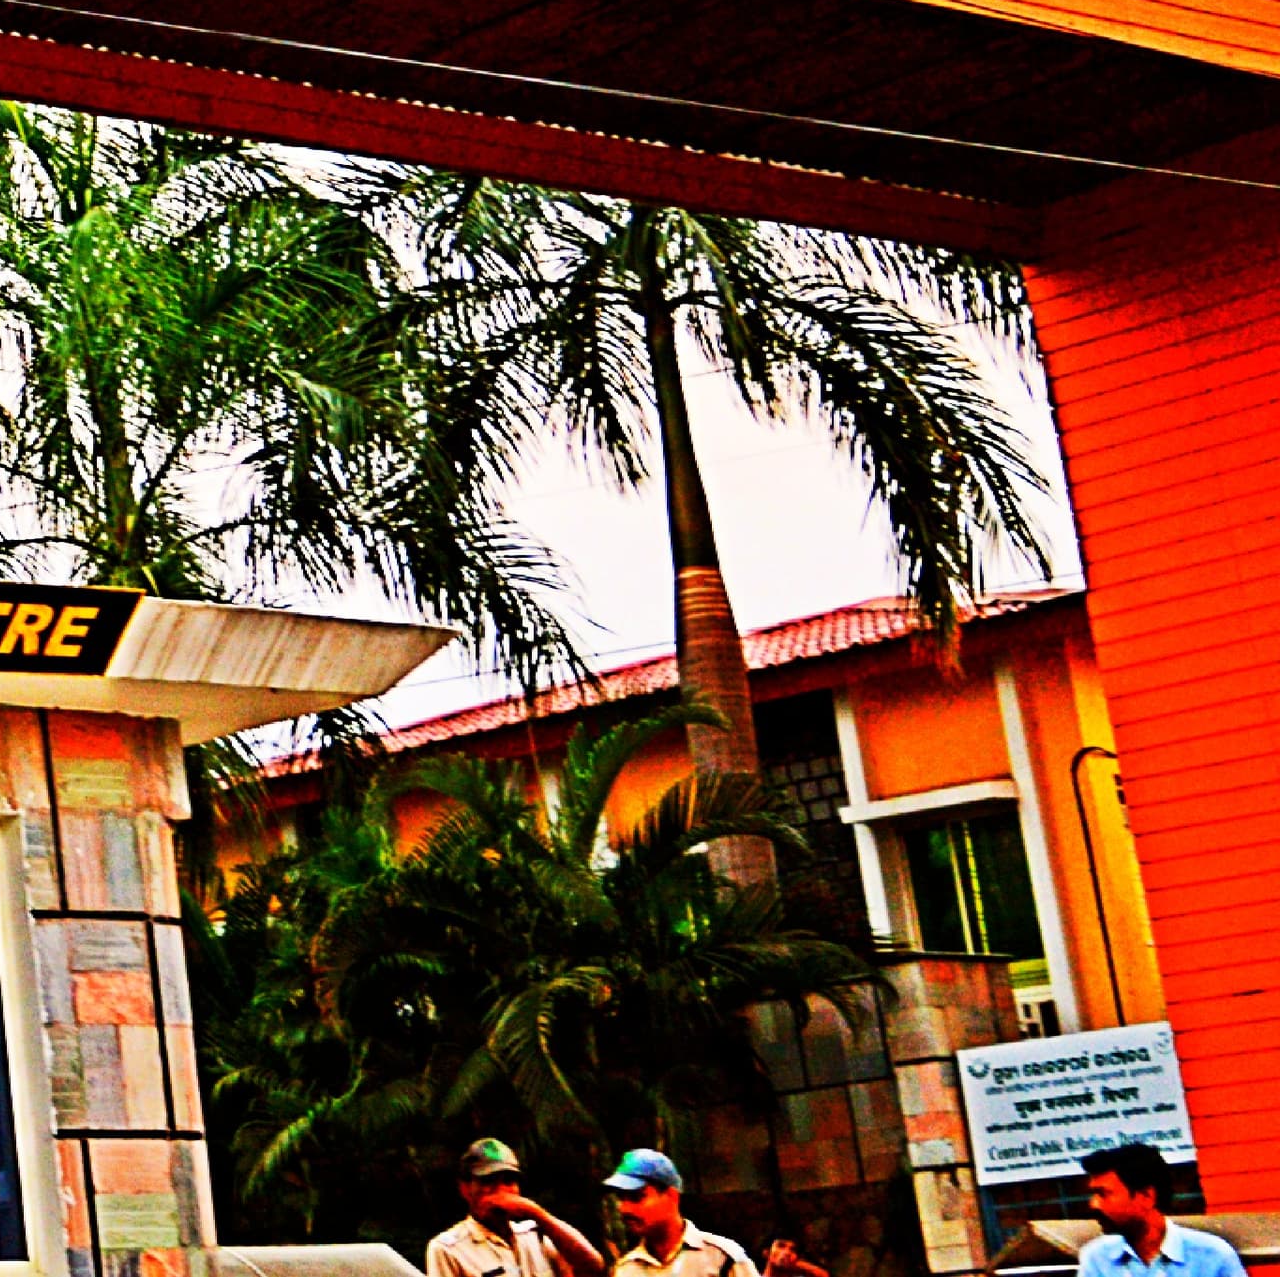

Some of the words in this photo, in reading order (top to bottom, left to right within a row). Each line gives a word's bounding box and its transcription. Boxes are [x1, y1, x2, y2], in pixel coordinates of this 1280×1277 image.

[987, 1142, 1029, 1160] Central
[1030, 1140, 1064, 1156] Public
[1065, 1134, 1114, 1152] Relations
